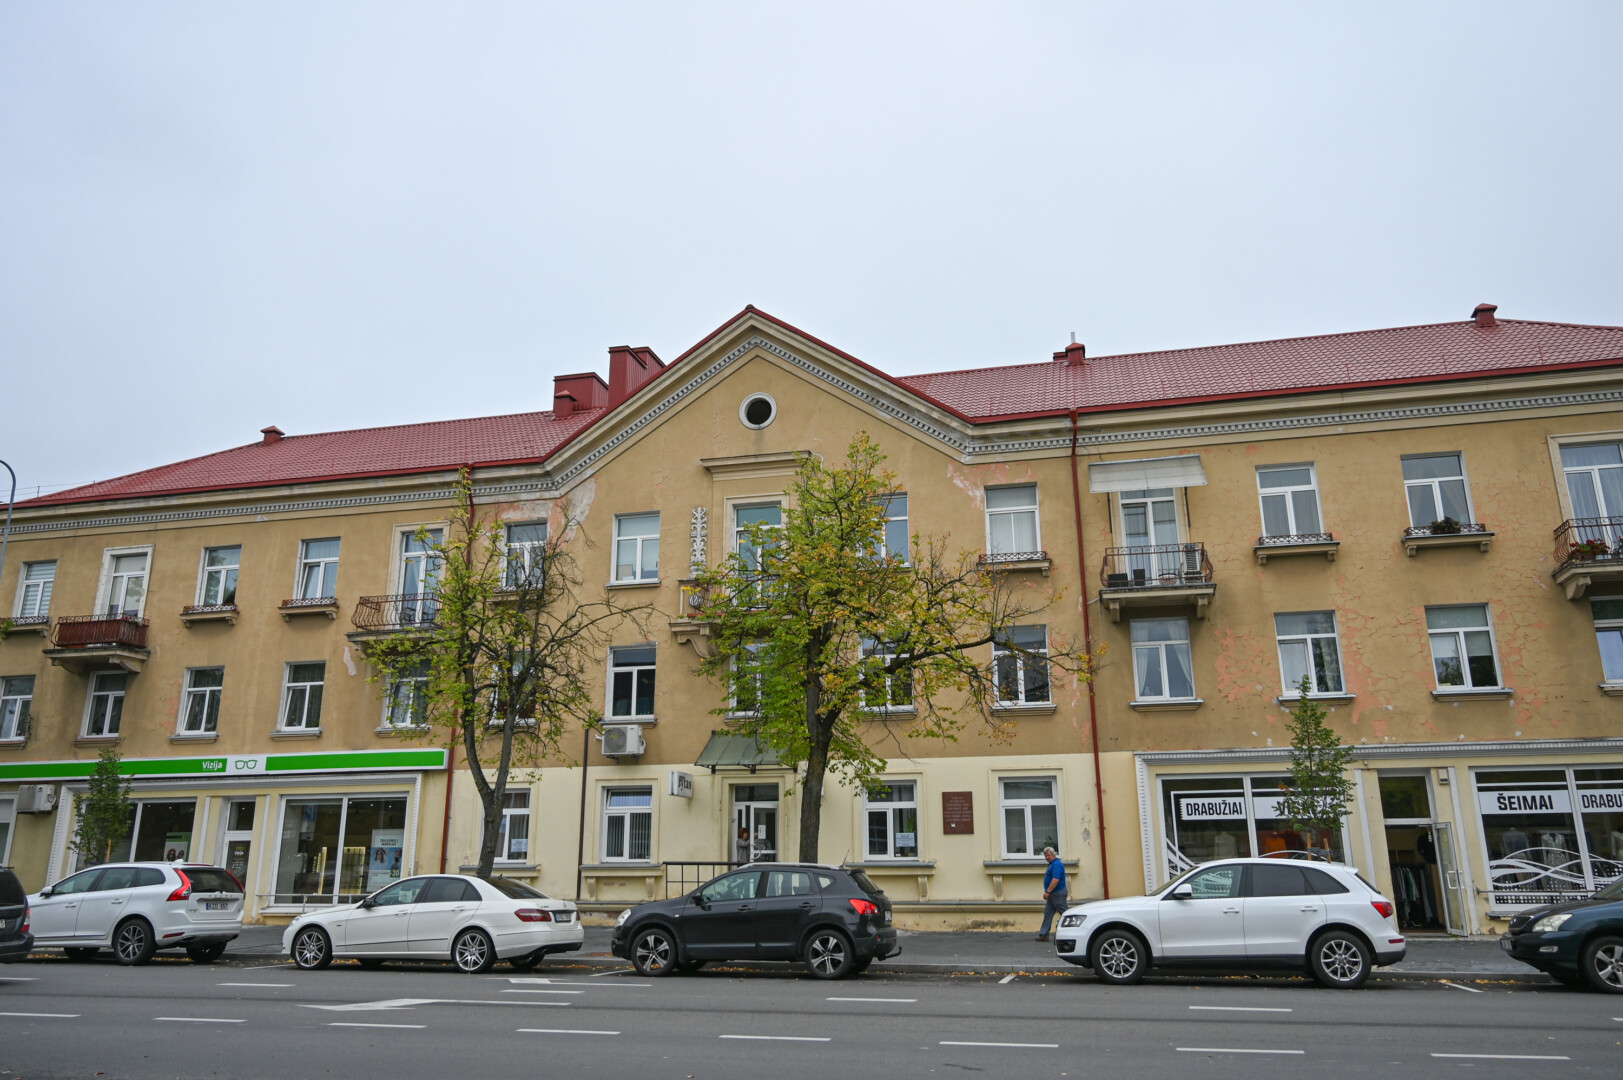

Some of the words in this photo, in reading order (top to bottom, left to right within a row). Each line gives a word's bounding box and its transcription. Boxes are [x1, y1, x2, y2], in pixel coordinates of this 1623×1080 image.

[202, 761, 223, 771] Vizija
[1186, 800, 1243, 816] DRABUŽIAI
[1497, 793, 1554, 811] ŠEIMAI
